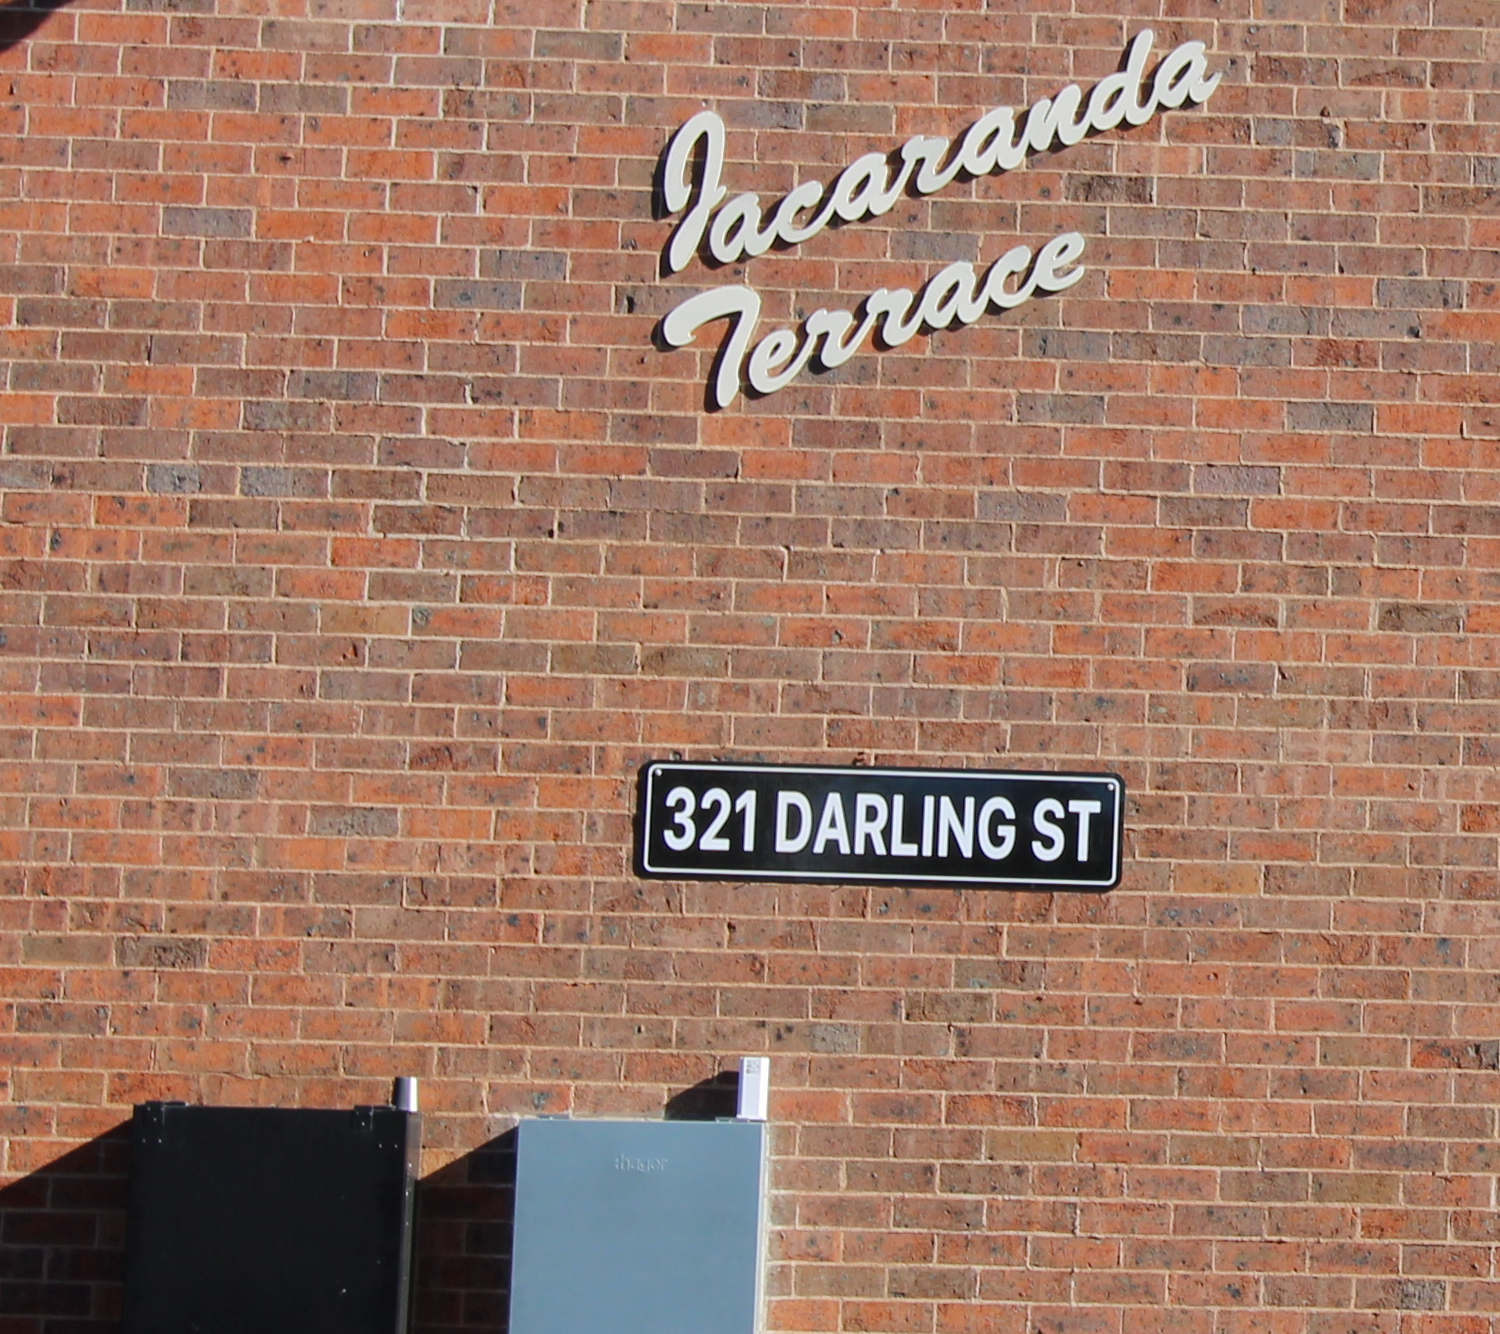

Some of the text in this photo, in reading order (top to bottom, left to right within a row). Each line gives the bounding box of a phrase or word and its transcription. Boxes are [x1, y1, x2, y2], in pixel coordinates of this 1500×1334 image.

[663, 28, 1222, 273] Jacaranda
[663, 230, 1087, 408] Terrace
[663, 786, 1103, 863] 321 DARLING ST
